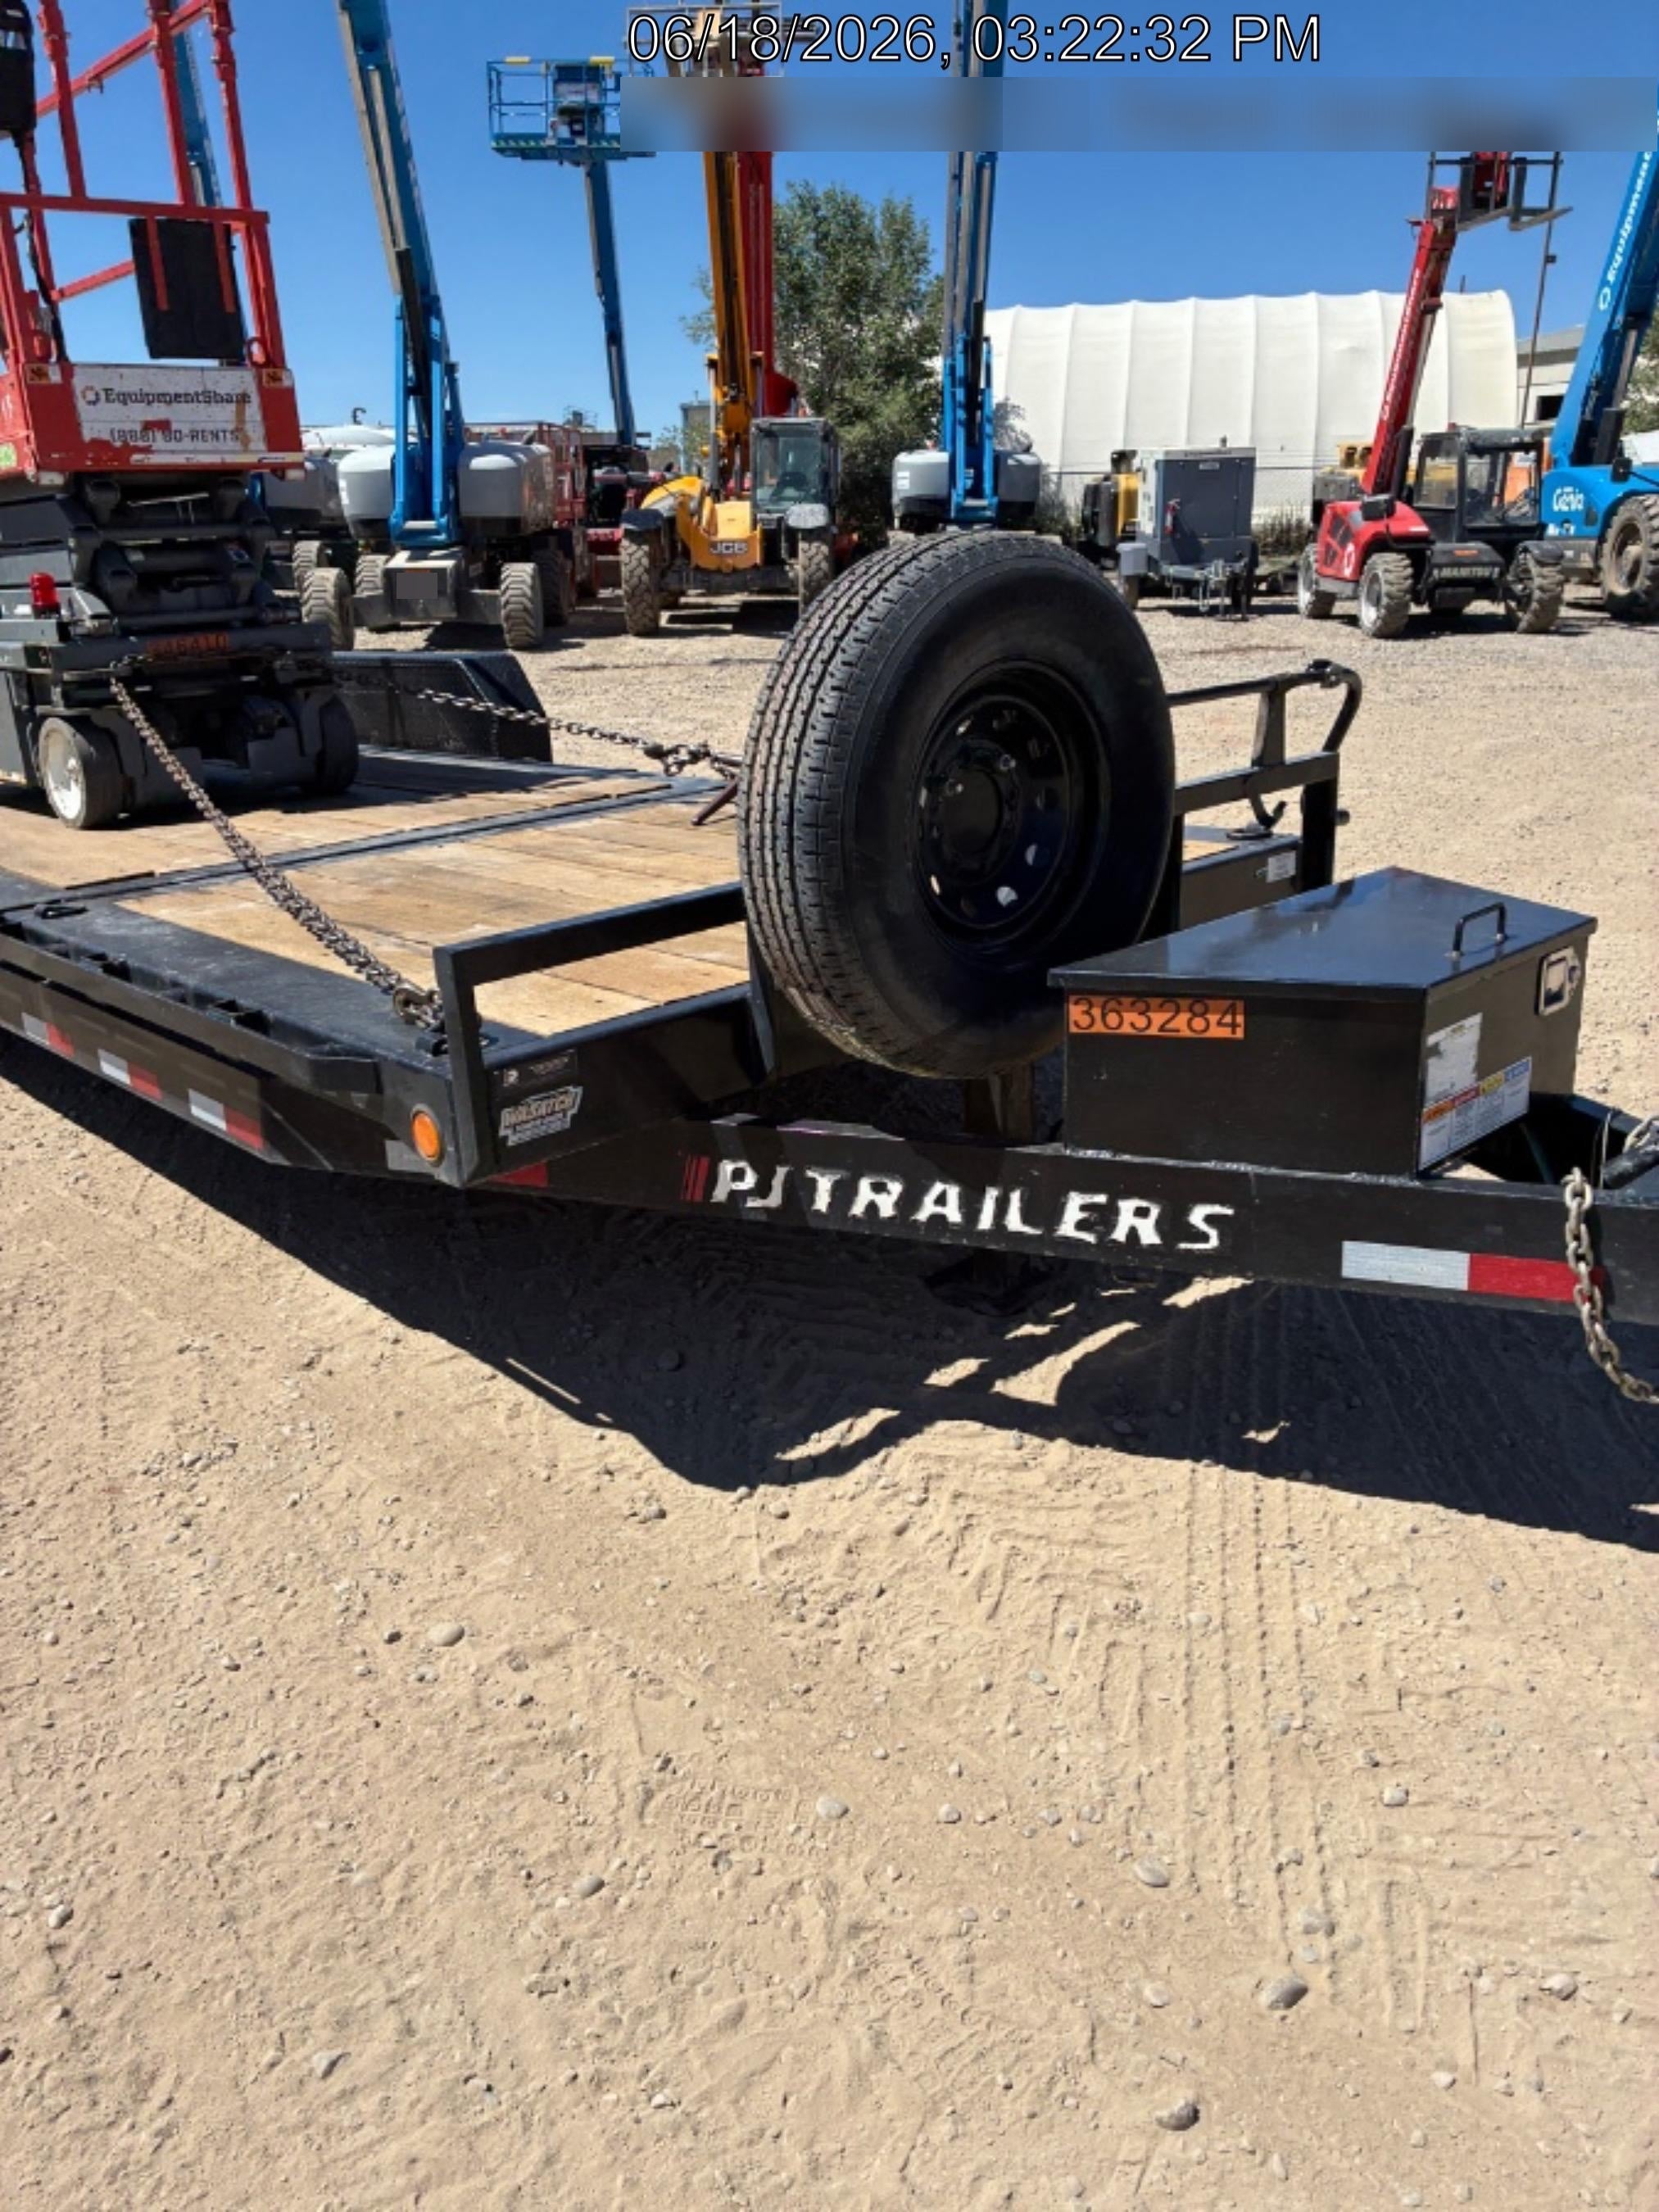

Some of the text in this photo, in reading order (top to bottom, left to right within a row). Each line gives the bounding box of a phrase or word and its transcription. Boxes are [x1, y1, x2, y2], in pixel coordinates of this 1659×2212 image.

[102, 388, 252, 406] EquipmentShare
[709, 542, 747, 555] JCB
[1072, 996, 1242, 1036] 363284
[709, 1159, 1235, 1250] PJ TRAILERS
